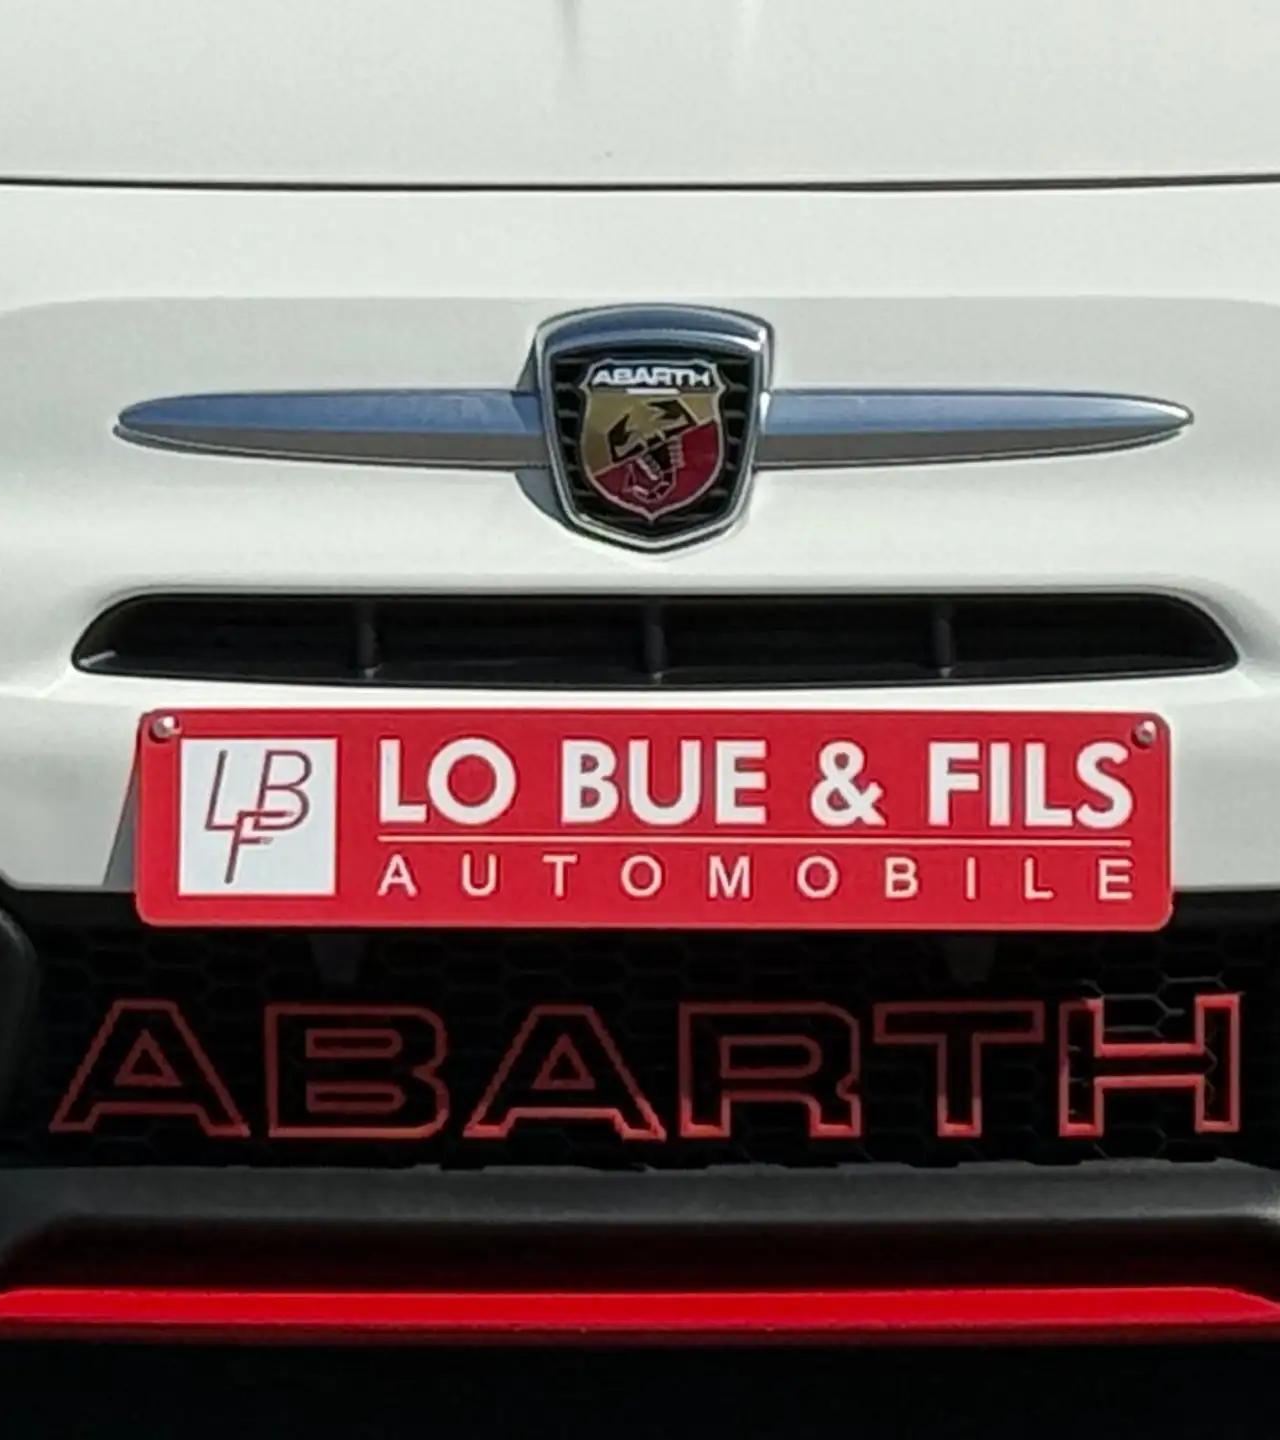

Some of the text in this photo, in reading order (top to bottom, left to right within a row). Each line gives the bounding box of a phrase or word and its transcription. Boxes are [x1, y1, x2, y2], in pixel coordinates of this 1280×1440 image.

[592, 366, 710, 387] ABARTH
[377, 737, 1133, 829] LO BUE & FILS
[376, 853, 1133, 901] AUTOMOBILE
[48, 993, 1241, 1142] ABARTH
